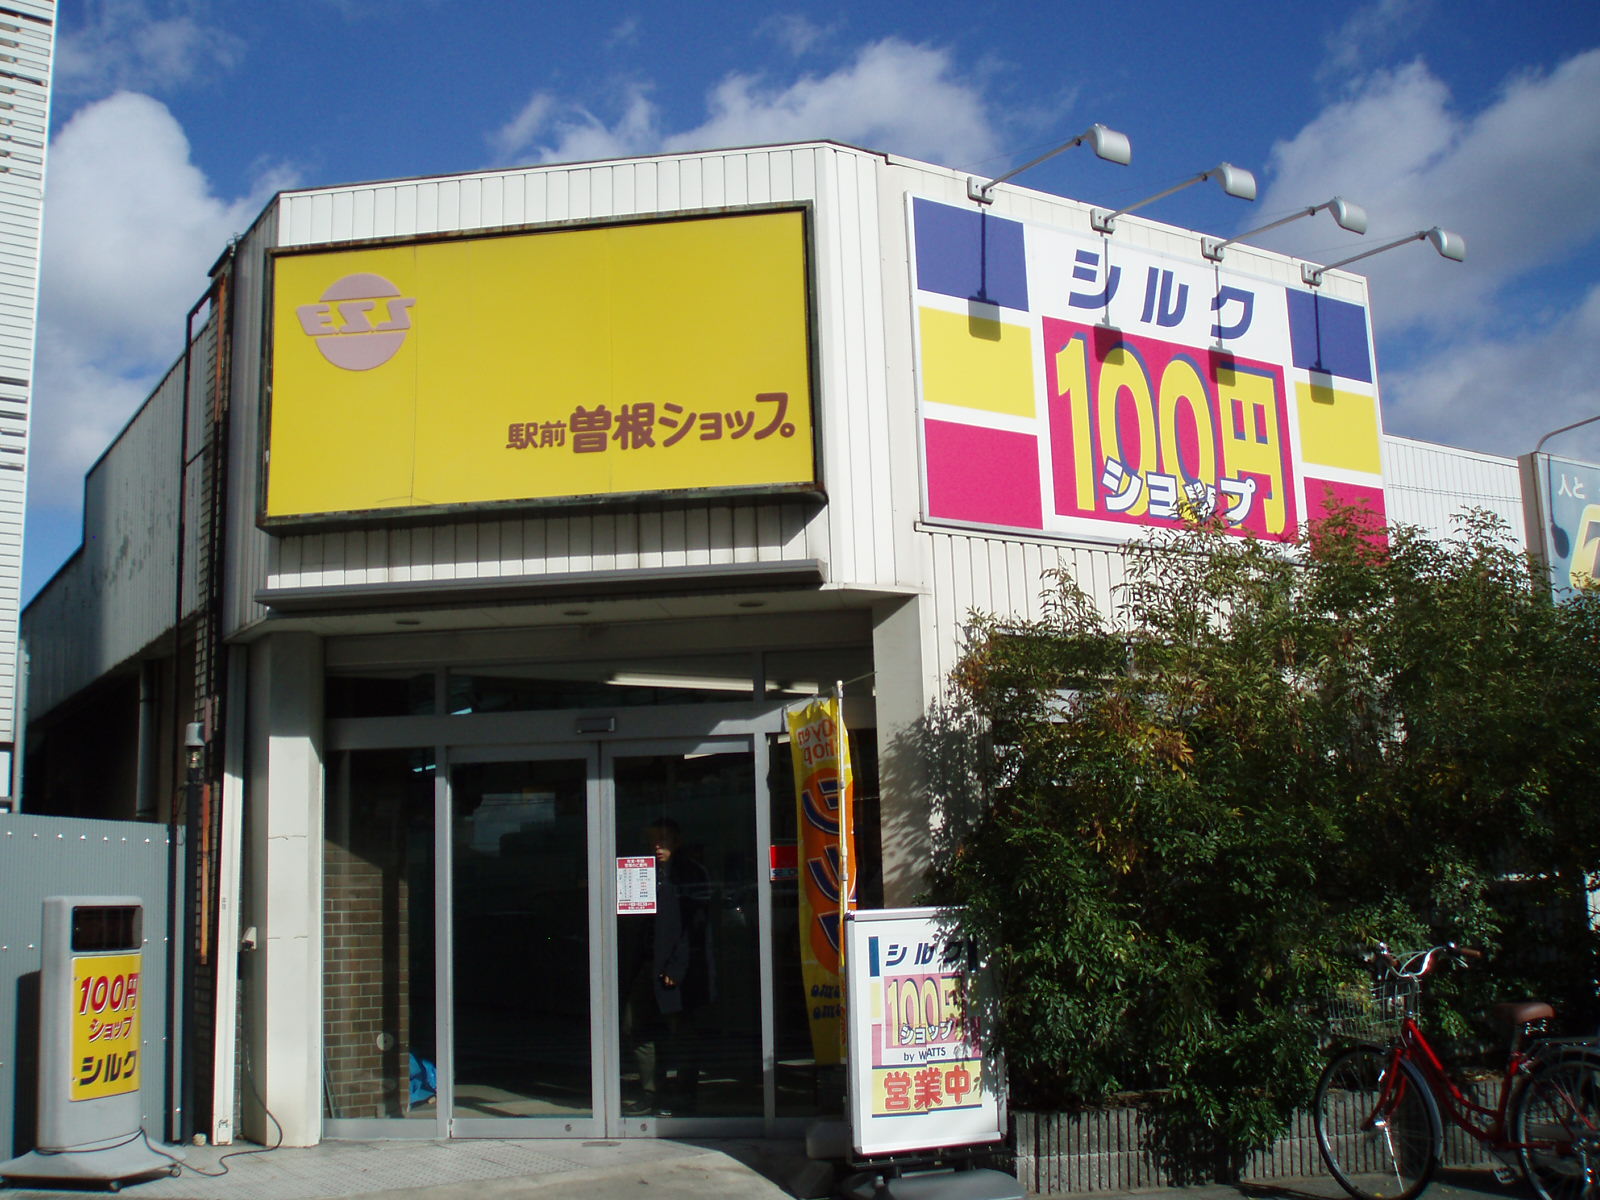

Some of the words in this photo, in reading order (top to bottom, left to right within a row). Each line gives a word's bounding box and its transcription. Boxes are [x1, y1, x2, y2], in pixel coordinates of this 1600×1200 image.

[1068, 248, 1255, 340] シルク
[1055, 330, 1290, 535] 100円
[1102, 456, 1256, 526] ショップ
[885, 941, 963, 967] シルク
[79, 973, 139, 1016] 100円
[88, 1014, 134, 1043] ショップ
[79, 1049, 138, 1087] シルク
[903, 1052, 915, 1062] by
[918, 1046, 947, 1060] WATTS
[883, 1064, 972, 1112] 営業中
